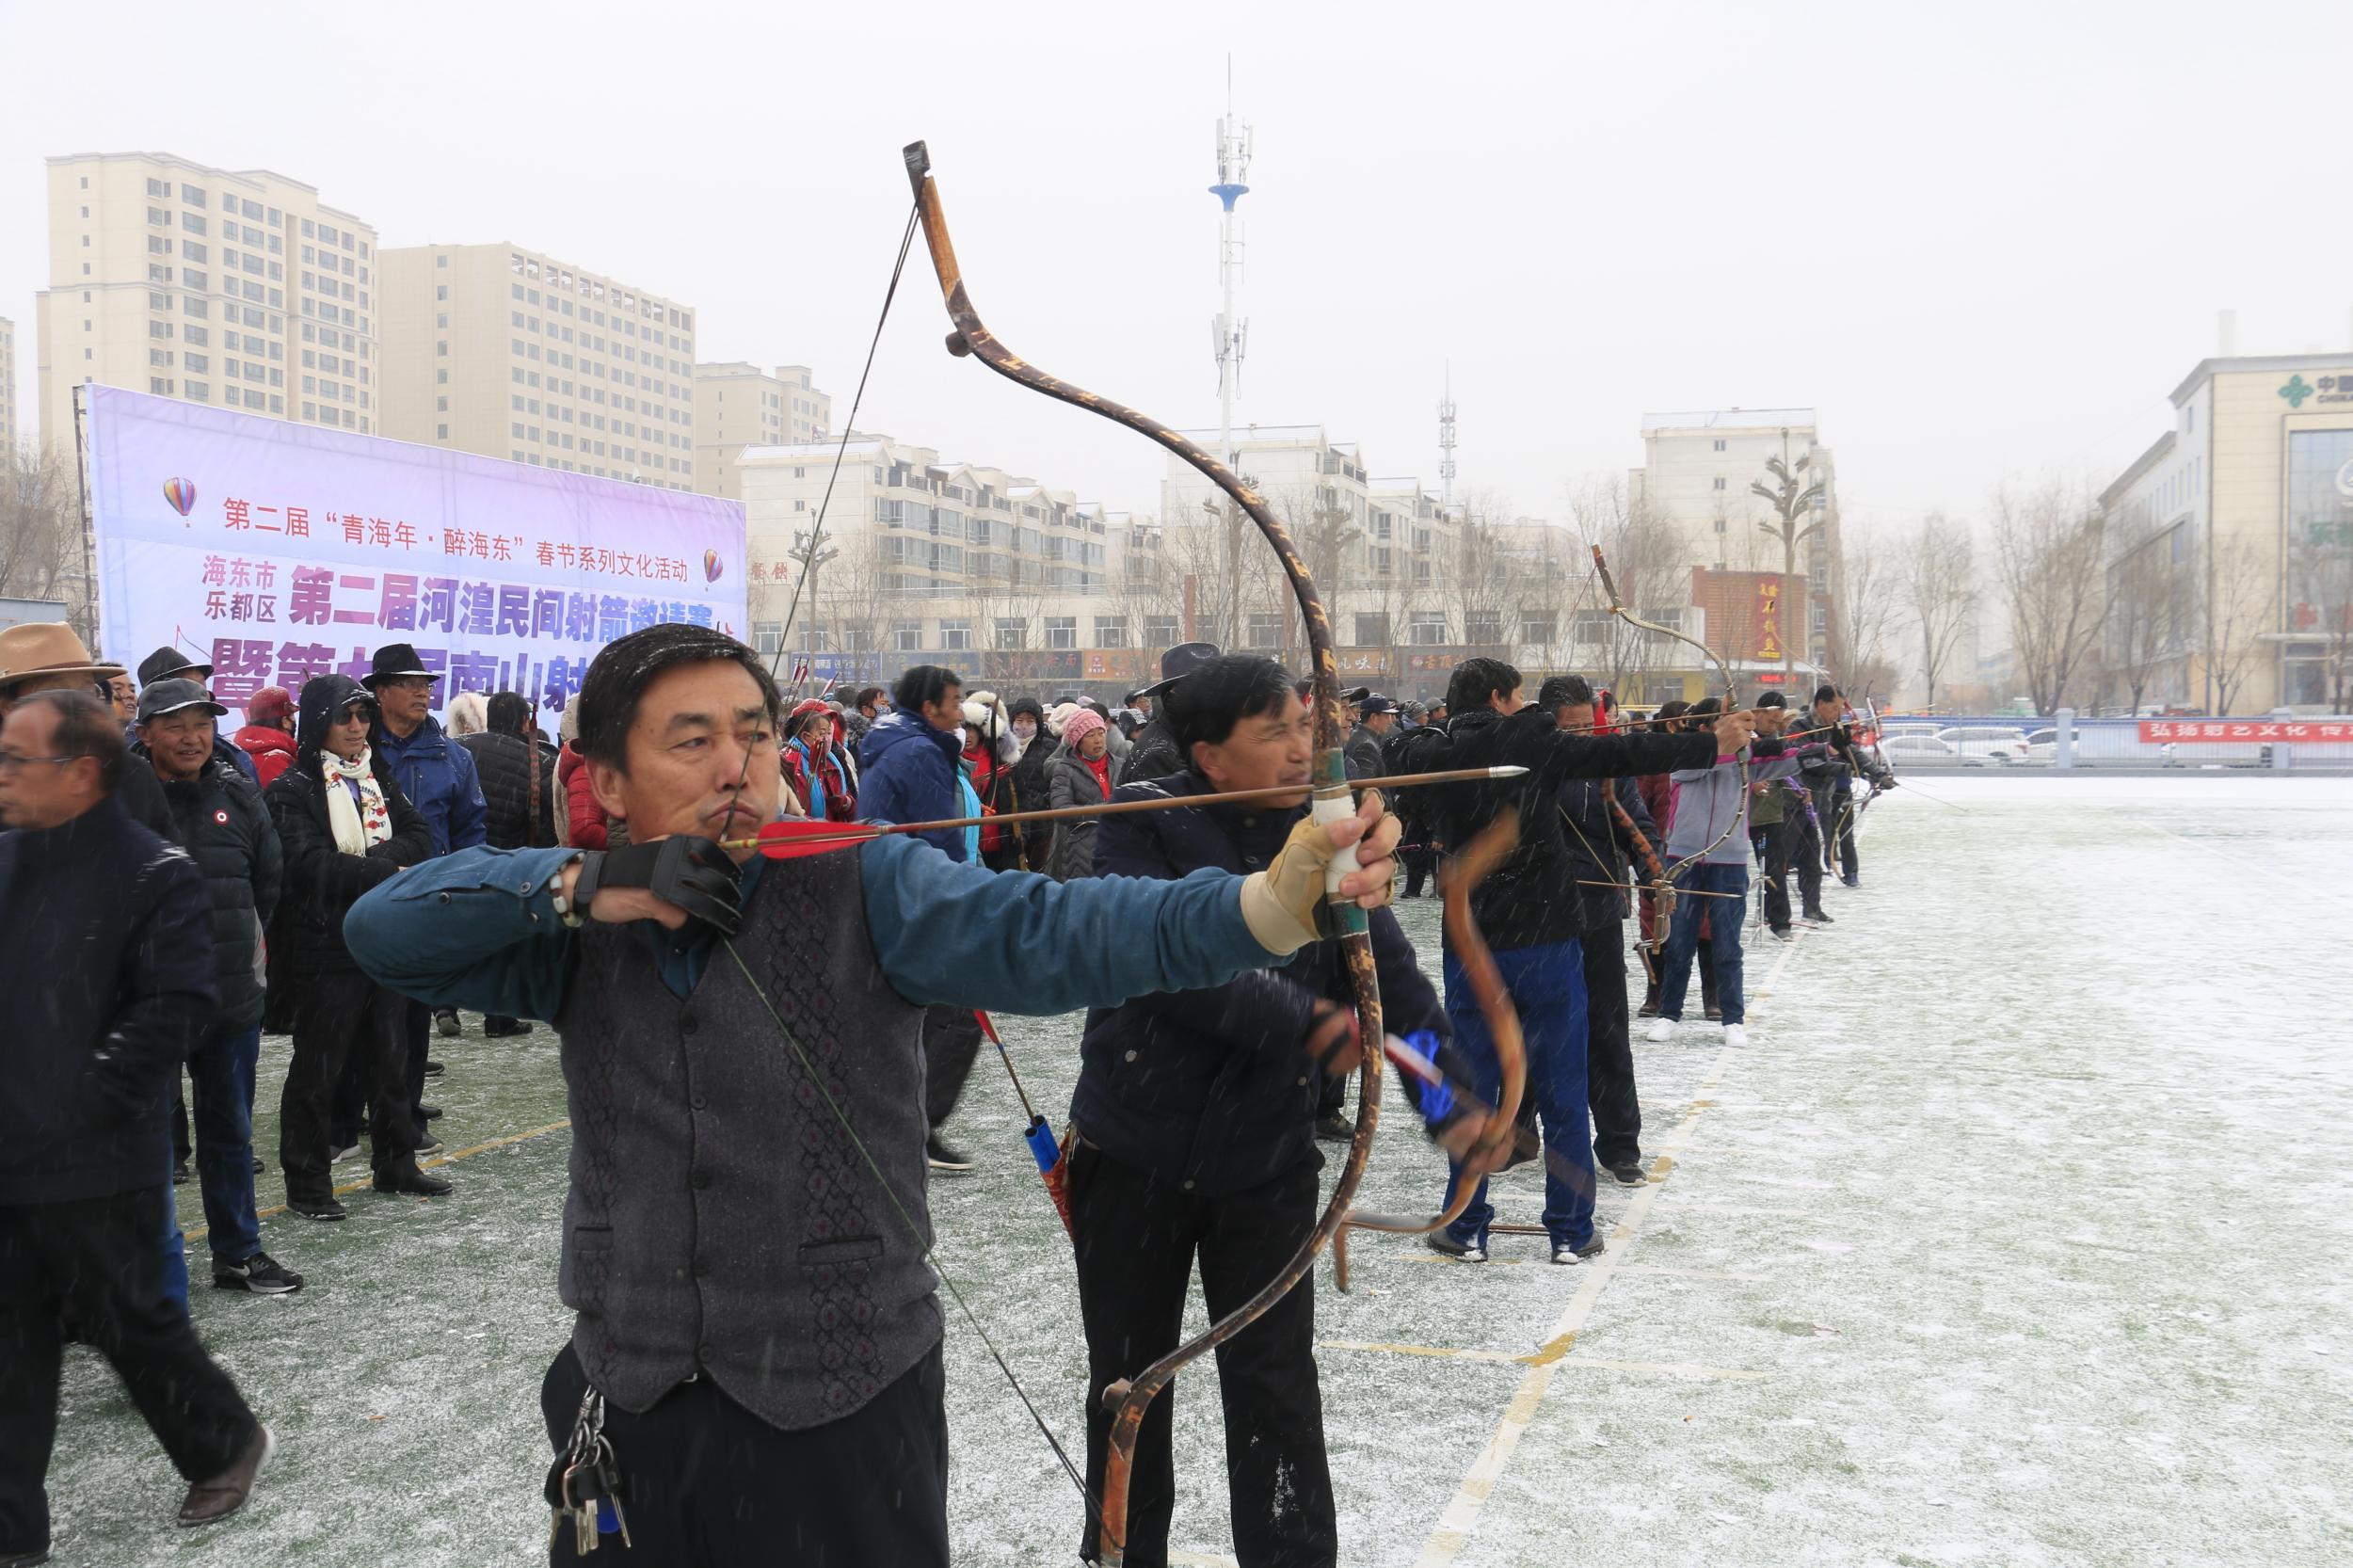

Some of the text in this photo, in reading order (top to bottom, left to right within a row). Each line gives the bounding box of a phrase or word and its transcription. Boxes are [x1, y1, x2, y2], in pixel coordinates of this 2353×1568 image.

[223, 496, 310, 537] 第二届
[536, 539, 688, 583] 春节系列文化活动
[201, 554, 277, 590] 海东市
[204, 590, 277, 623] 乐都区
[2320, 726, 2353, 736] 传
